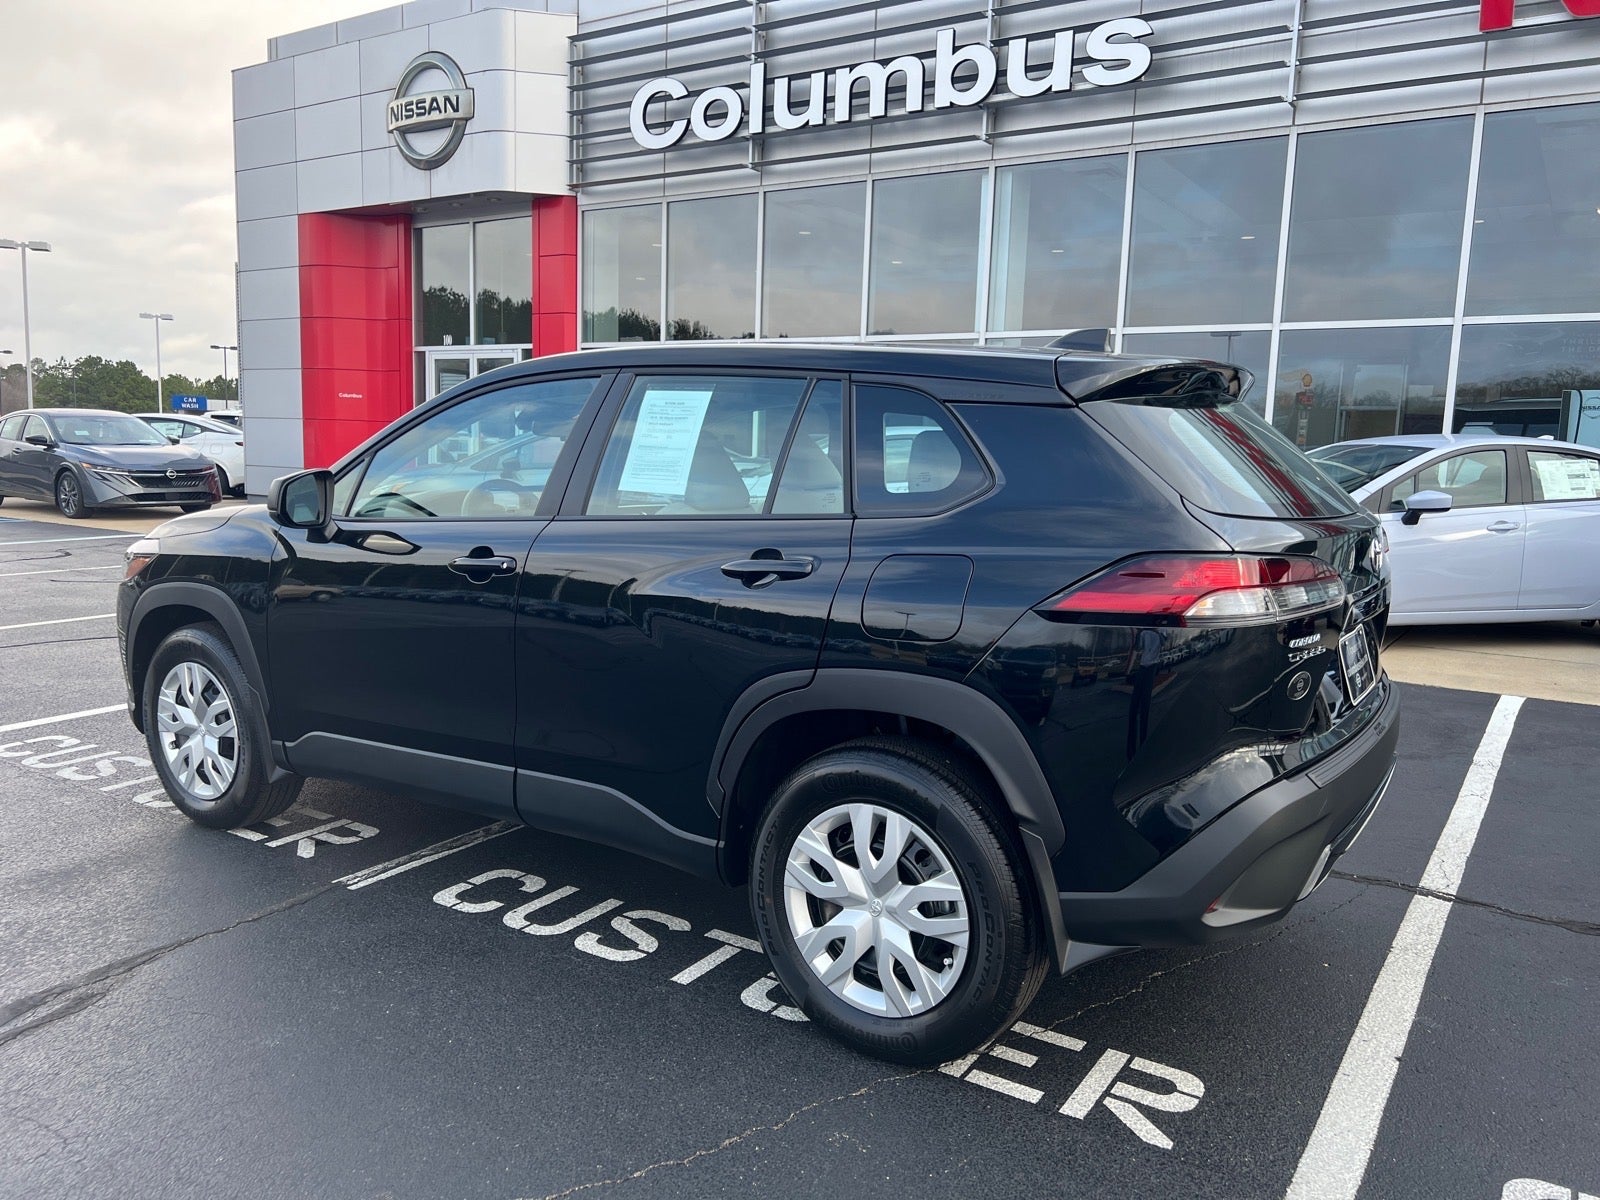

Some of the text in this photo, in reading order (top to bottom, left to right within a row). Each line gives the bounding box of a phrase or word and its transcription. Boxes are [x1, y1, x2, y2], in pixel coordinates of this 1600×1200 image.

[390, 94, 460, 125] NISSAN
[629, 17, 1155, 149] Columbus
[443, 334, 453, 346] 100
[433, 868, 1206, 1150] CUSTER
